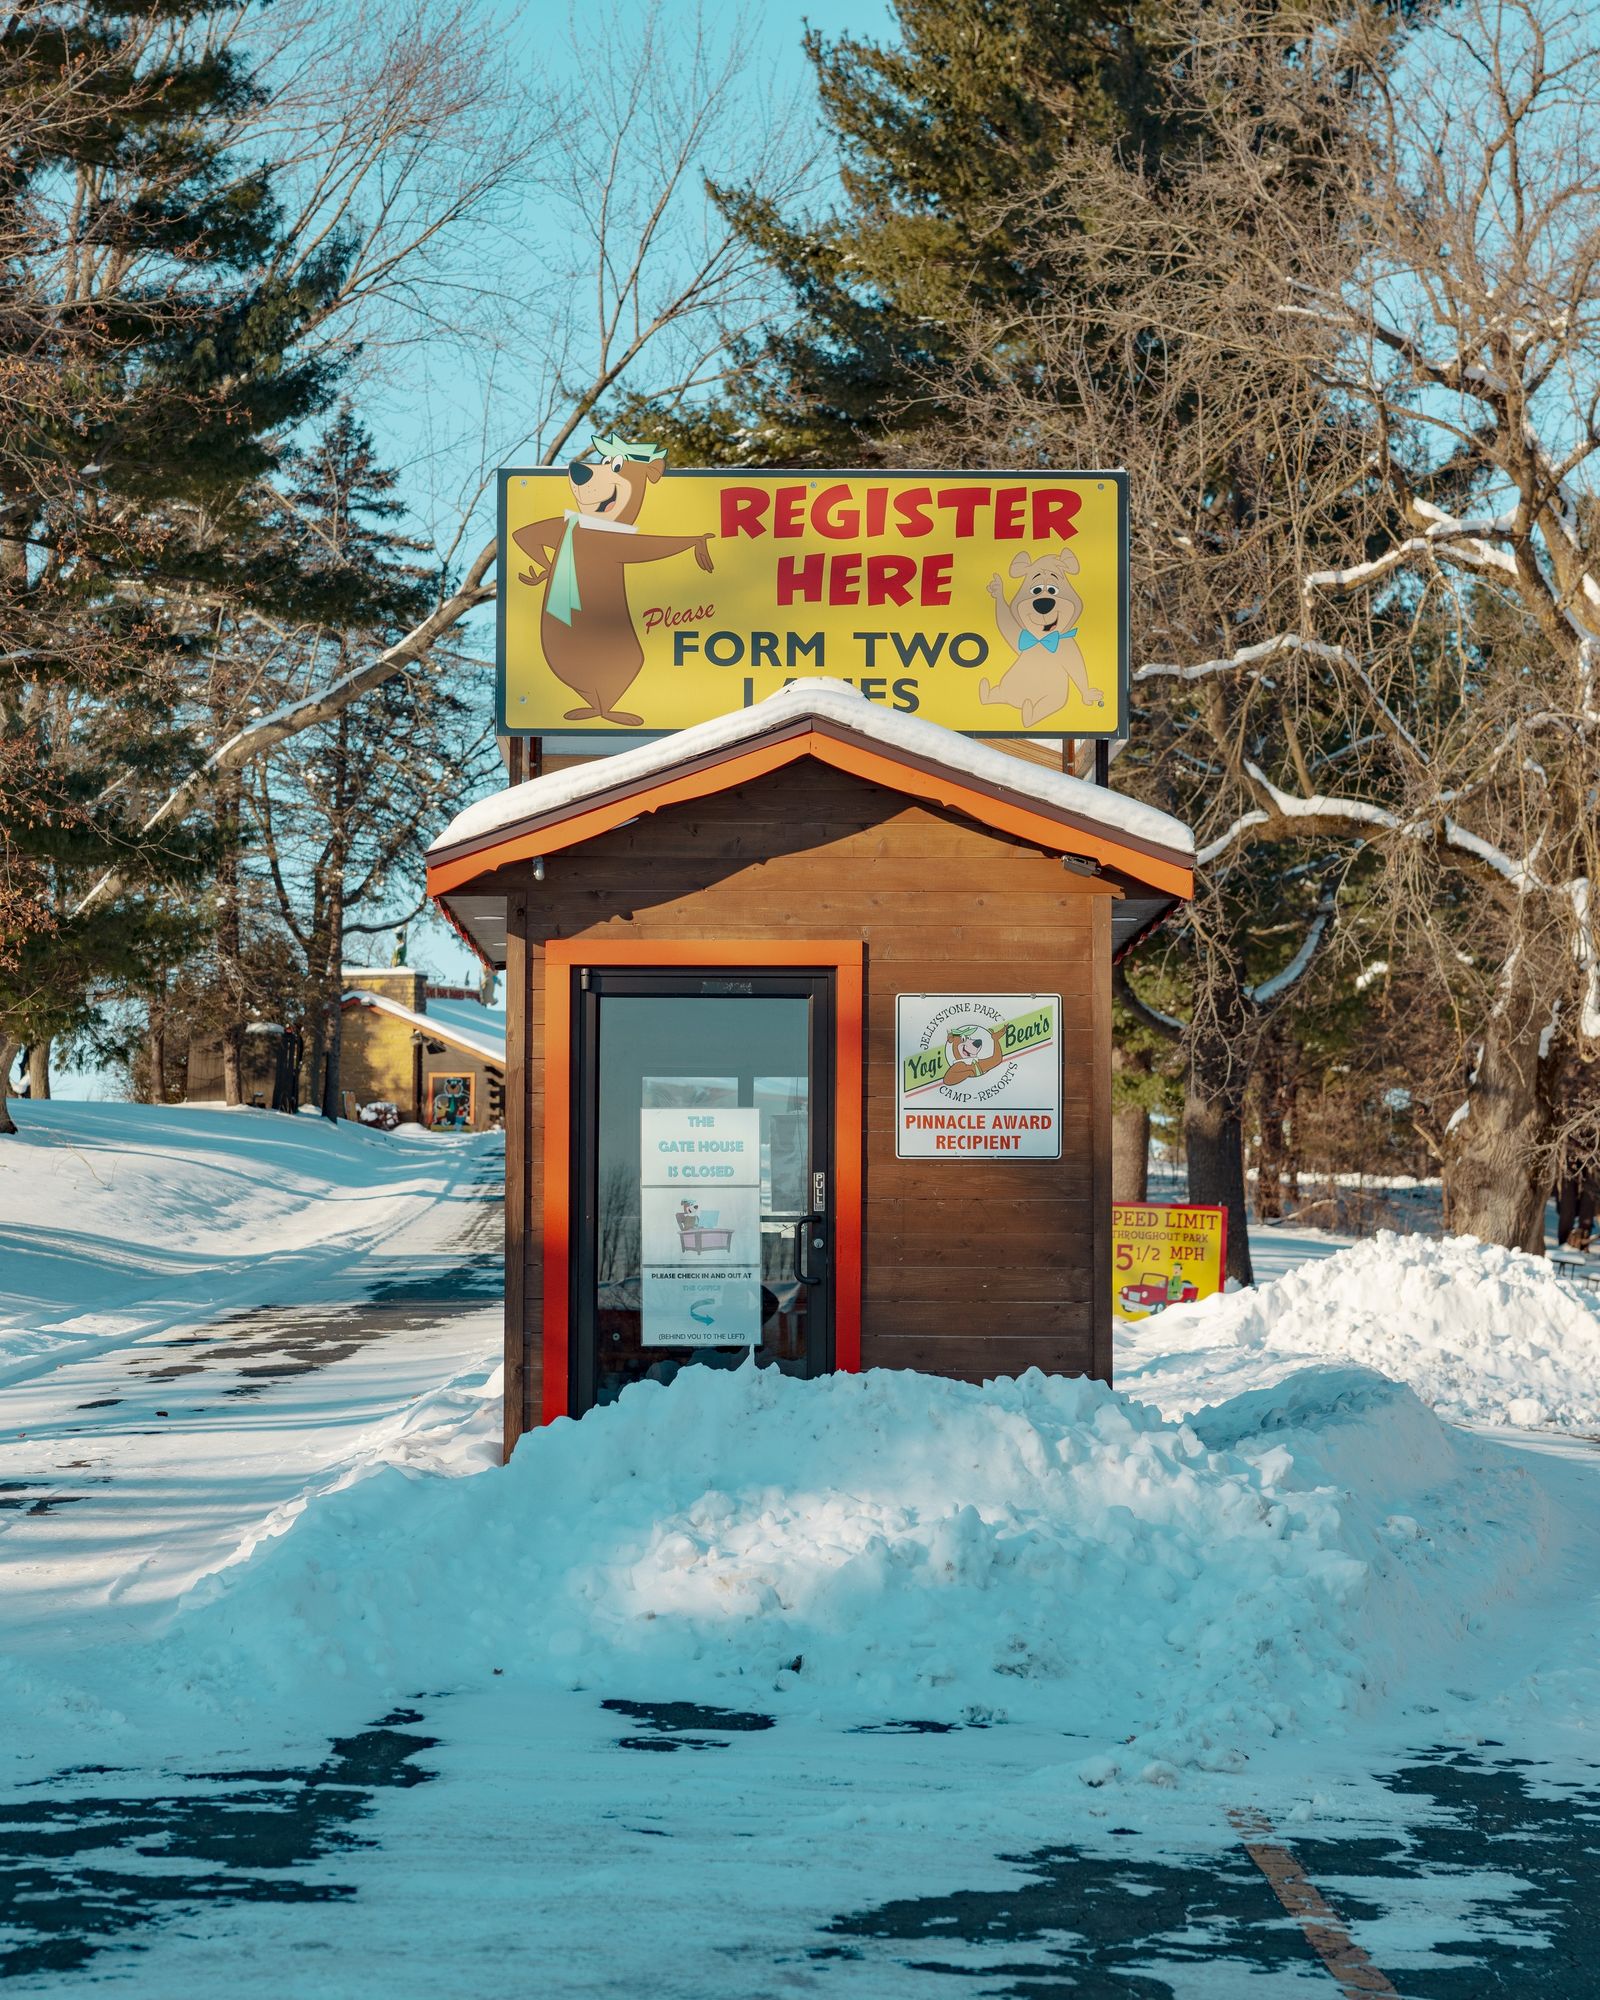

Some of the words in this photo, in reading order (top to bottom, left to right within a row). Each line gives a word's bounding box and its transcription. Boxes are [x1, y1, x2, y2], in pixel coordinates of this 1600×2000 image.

[719, 484, 1083, 542] REGISTER
[776, 552, 954, 607] HERE
[643, 601, 716, 635] Please
[673, 631, 825, 668] FORM
[854, 631, 990, 669] TWO
[743, 678, 920, 714] LES
[920, 1003, 971, 1050] JELLYSTONE
[974, 1003, 1002, 1022] PARK
[908, 1051, 943, 1079] Yogi
[1005, 1015, 1050, 1048] Bear's
[687, 1116, 715, 1128] THE
[905, 1115, 986, 1130] PINNACLE
[992, 1115, 1052, 1130] AWARD
[658, 1140, 695, 1153] GATE
[698, 1140, 744, 1153] HOUSE
[936, 1135, 1021, 1150] RECIPIENT
[668, 1166, 678, 1178] IS
[682, 1165, 735, 1178] CLOSED
[815, 1174, 823, 1204] PULL
[1112, 1210, 1159, 1227] PEED
[1165, 1212, 1218, 1230] LIMIT
[1112, 1230, 1182, 1241] THROUGHOUT
[1183, 1232, 1209, 1244] PARK
[1169, 1246, 1205, 1261] MPH
[658, 1333, 686, 1341] (BEHIND
[687, 1333, 702, 1341] YOU
[703, 1333, 713, 1341] TO
[714, 1333, 726, 1341] THE
[728, 1333, 746, 1341] LEFT)
